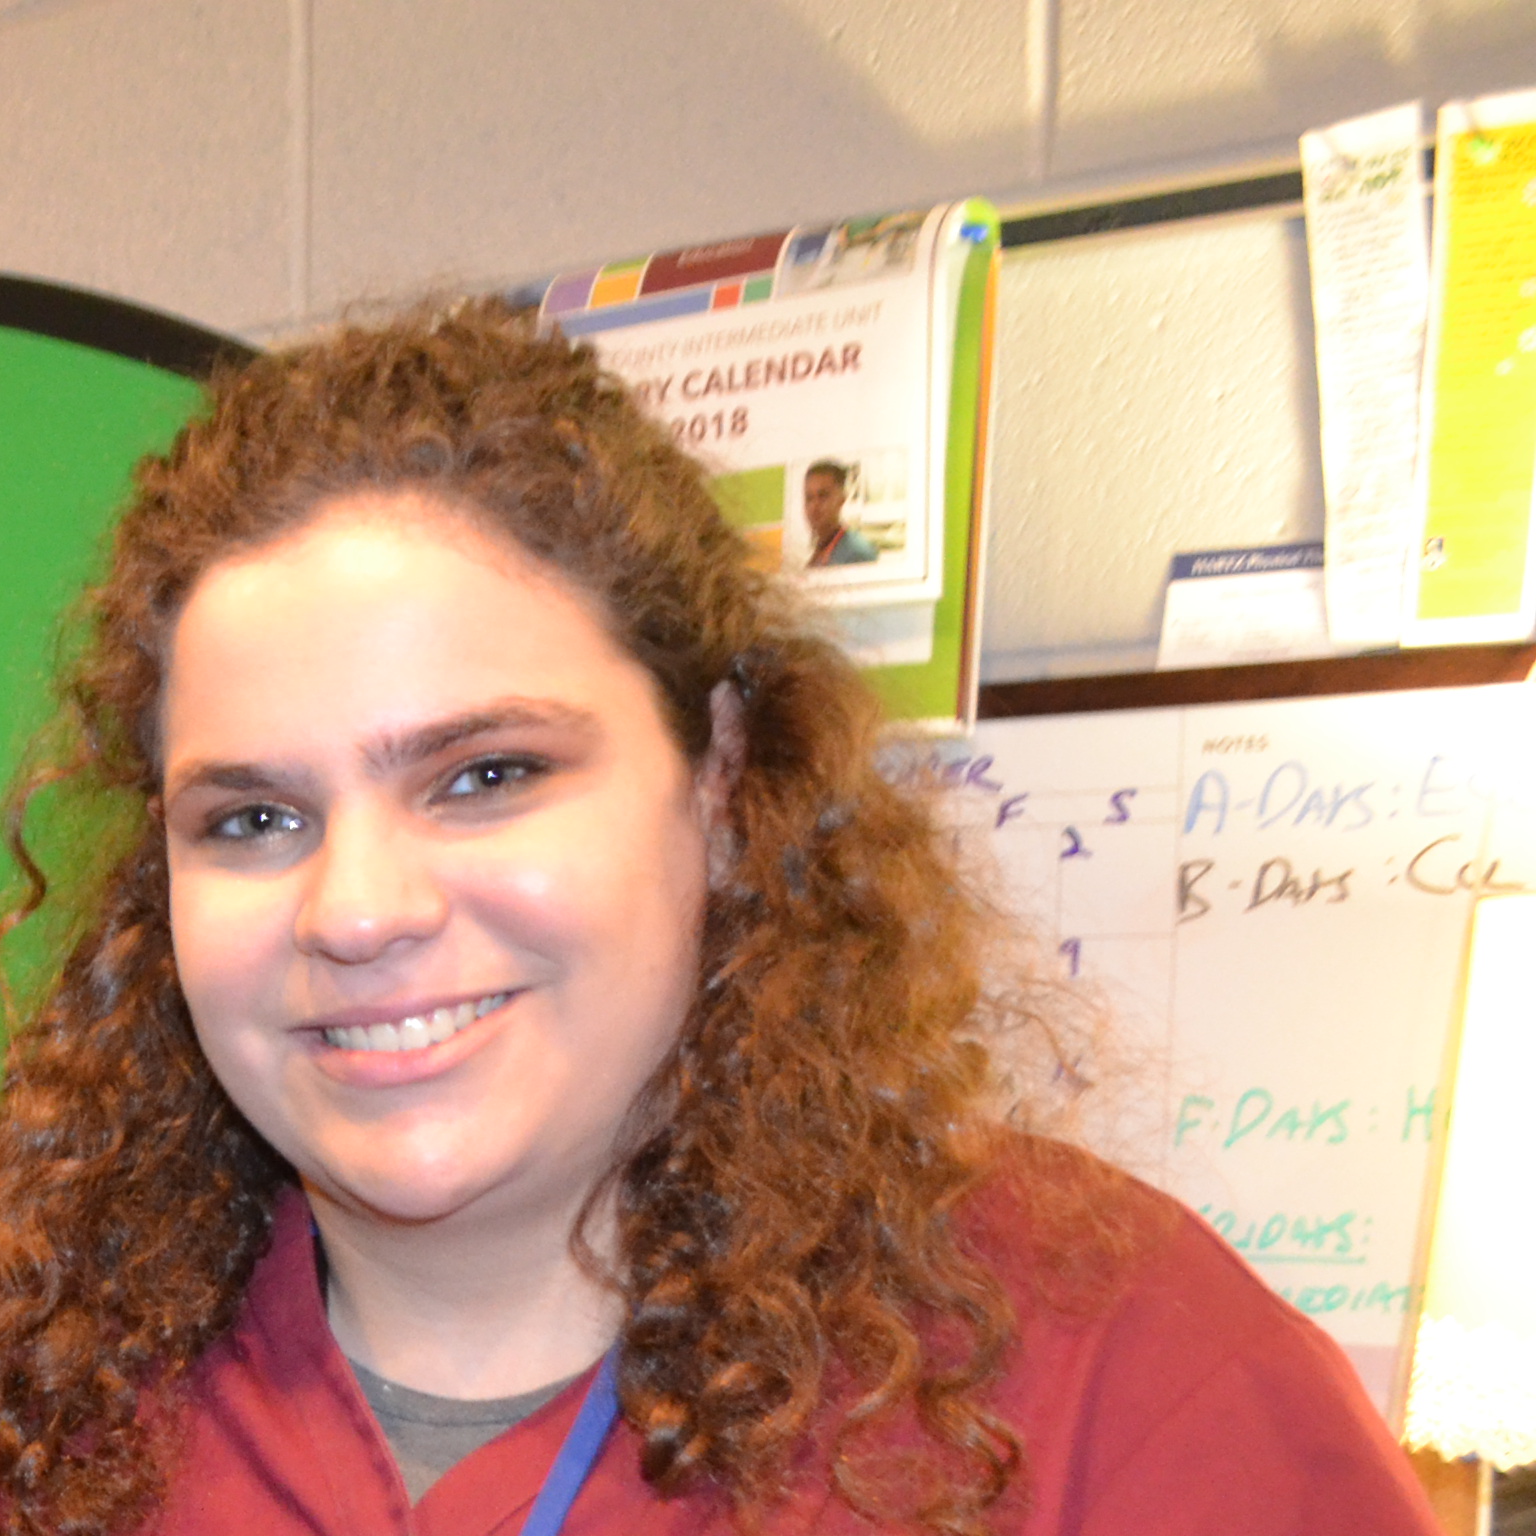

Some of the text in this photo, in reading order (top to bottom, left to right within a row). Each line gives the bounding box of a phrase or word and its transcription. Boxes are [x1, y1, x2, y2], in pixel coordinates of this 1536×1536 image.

[681, 340, 864, 401] CALENDAR
[994, 791, 1031, 829] F
[1059, 825, 1093, 862] 2
[1057, 936, 1081, 977] 9
[1198, 1203, 1374, 1254] RIDAYS:
